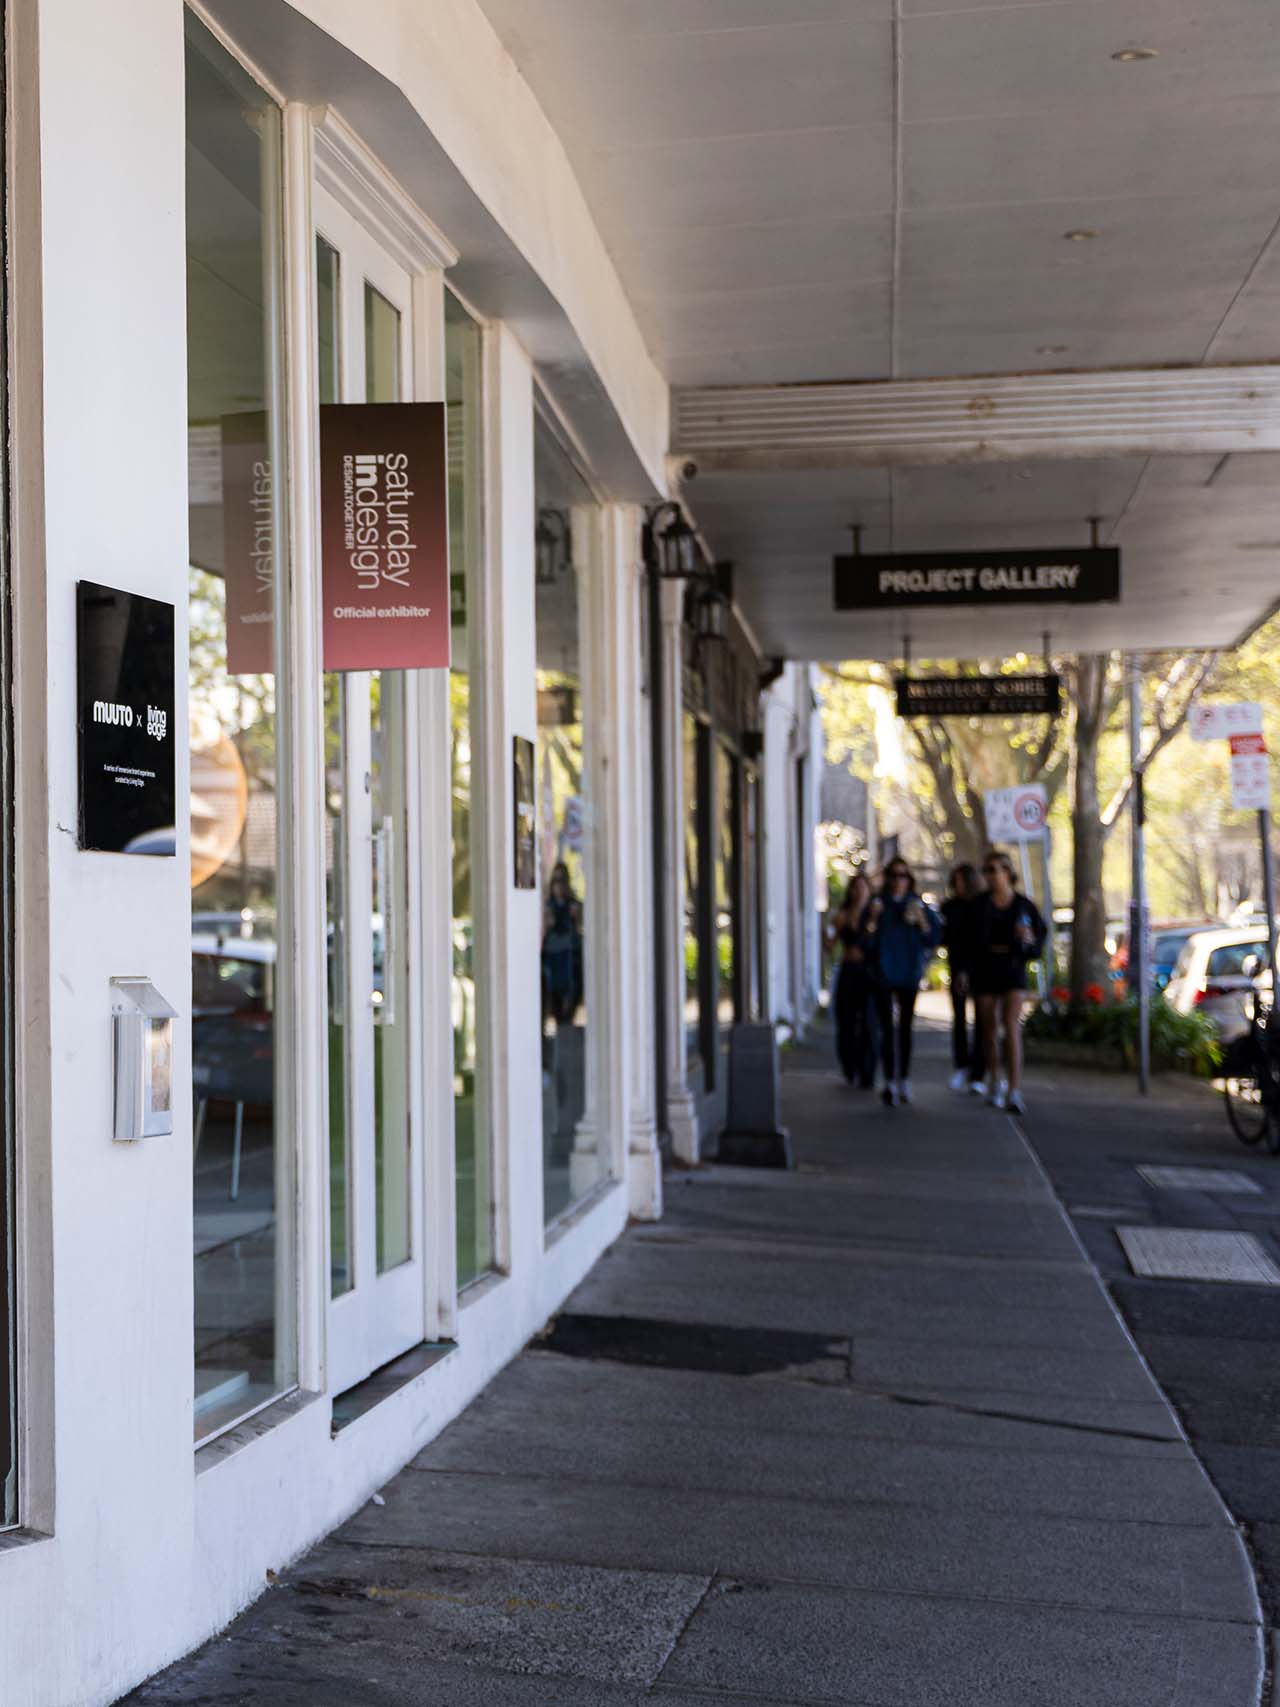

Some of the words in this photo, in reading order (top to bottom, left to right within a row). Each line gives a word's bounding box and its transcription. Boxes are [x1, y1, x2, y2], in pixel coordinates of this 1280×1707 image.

[350, 454, 386, 590] indesign
[381, 452, 417, 588] saturday
[879, 568, 975, 593] PROJECT
[979, 564, 1081, 590] GALLERY
[333, 606, 376, 619] Official
[377, 606, 431, 618] exhibitor
[147, 705, 166, 728] living
[147, 722, 166, 742] edge
